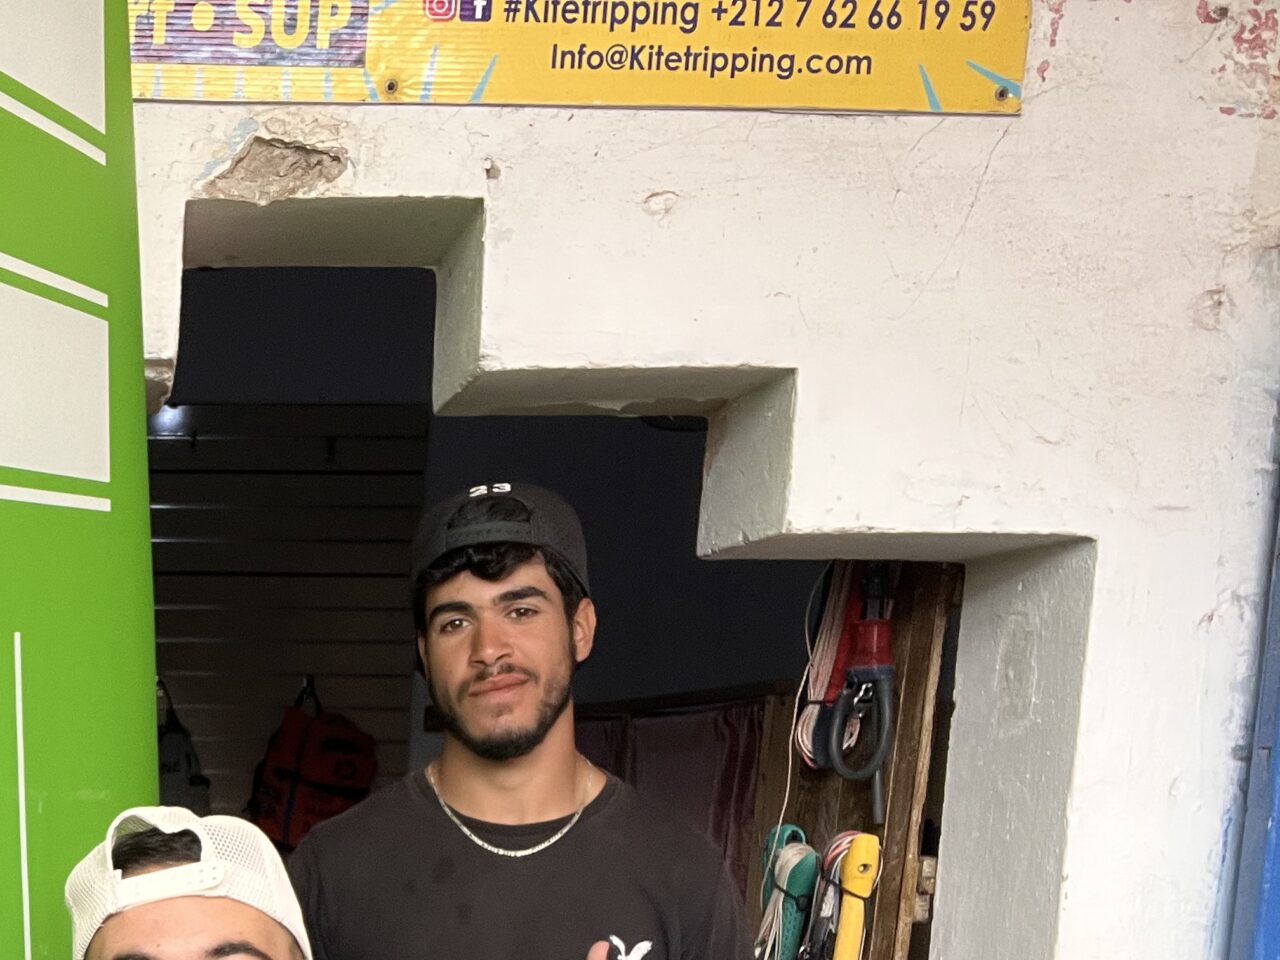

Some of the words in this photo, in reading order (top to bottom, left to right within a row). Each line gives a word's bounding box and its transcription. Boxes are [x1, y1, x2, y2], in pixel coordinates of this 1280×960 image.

[233, 0, 353, 50] SUP
[504, 0, 699, 34] #Kitetripping
[711, 0, 784, 27] +212
[795, 0, 813, 28] 7
[822, 0, 857, 29] 62
[868, 0, 903, 30] 66
[919, 0, 950, 31] 19
[959, 0, 997, 32] 59
[550, 43, 872, 80] Info@Kitetripping.com
[469, 482, 512, 497] 23
